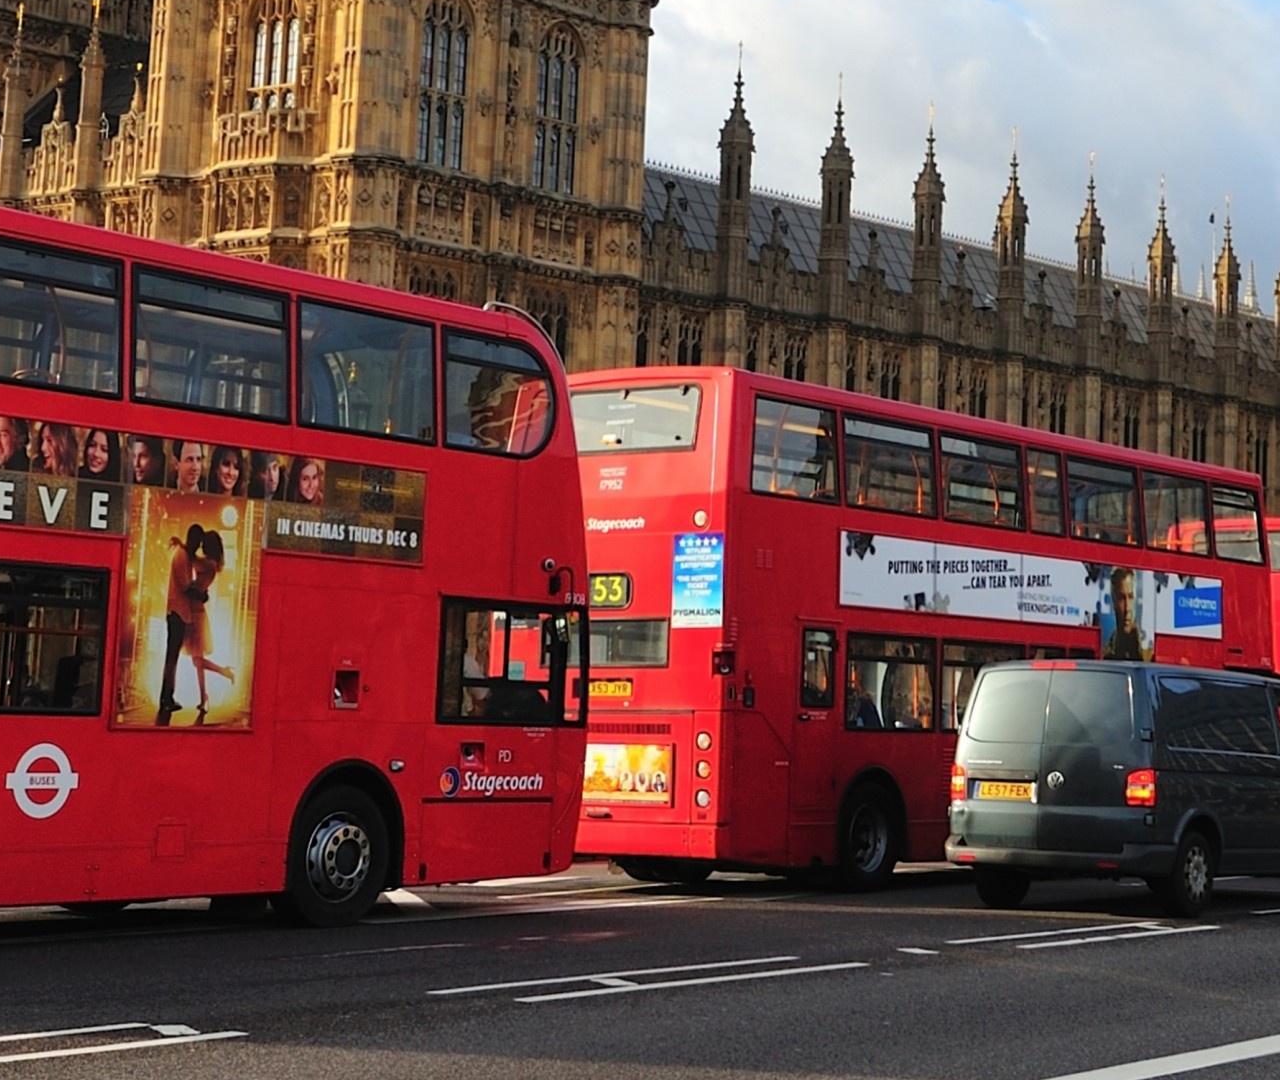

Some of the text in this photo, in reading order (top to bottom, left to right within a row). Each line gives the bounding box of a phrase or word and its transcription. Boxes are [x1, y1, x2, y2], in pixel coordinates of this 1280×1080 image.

[586, 517, 645, 533] Stagecoach
[277, 518, 417, 548] IN CINEMAS THURS DEC 8
[888, 560, 923, 574] PUTTING
[926, 561, 941, 573] THE
[943, 561, 969, 573] PIECES
[989, 575, 1007, 589] TEAR
[1009, 575, 1024, 588] YOU
[1026, 574, 1052, 588] APART.
[593, 576, 622, 602] 53
[673, 608, 720, 616] PYGMALION
[1017, 601, 1059, 615] WEEKNIGHTS
[498, 749, 512, 763] PD
[29, 776, 56, 786] BUSES
[463, 771, 543, 796] Stagecoach
[981, 784, 1007, 796] LE57
